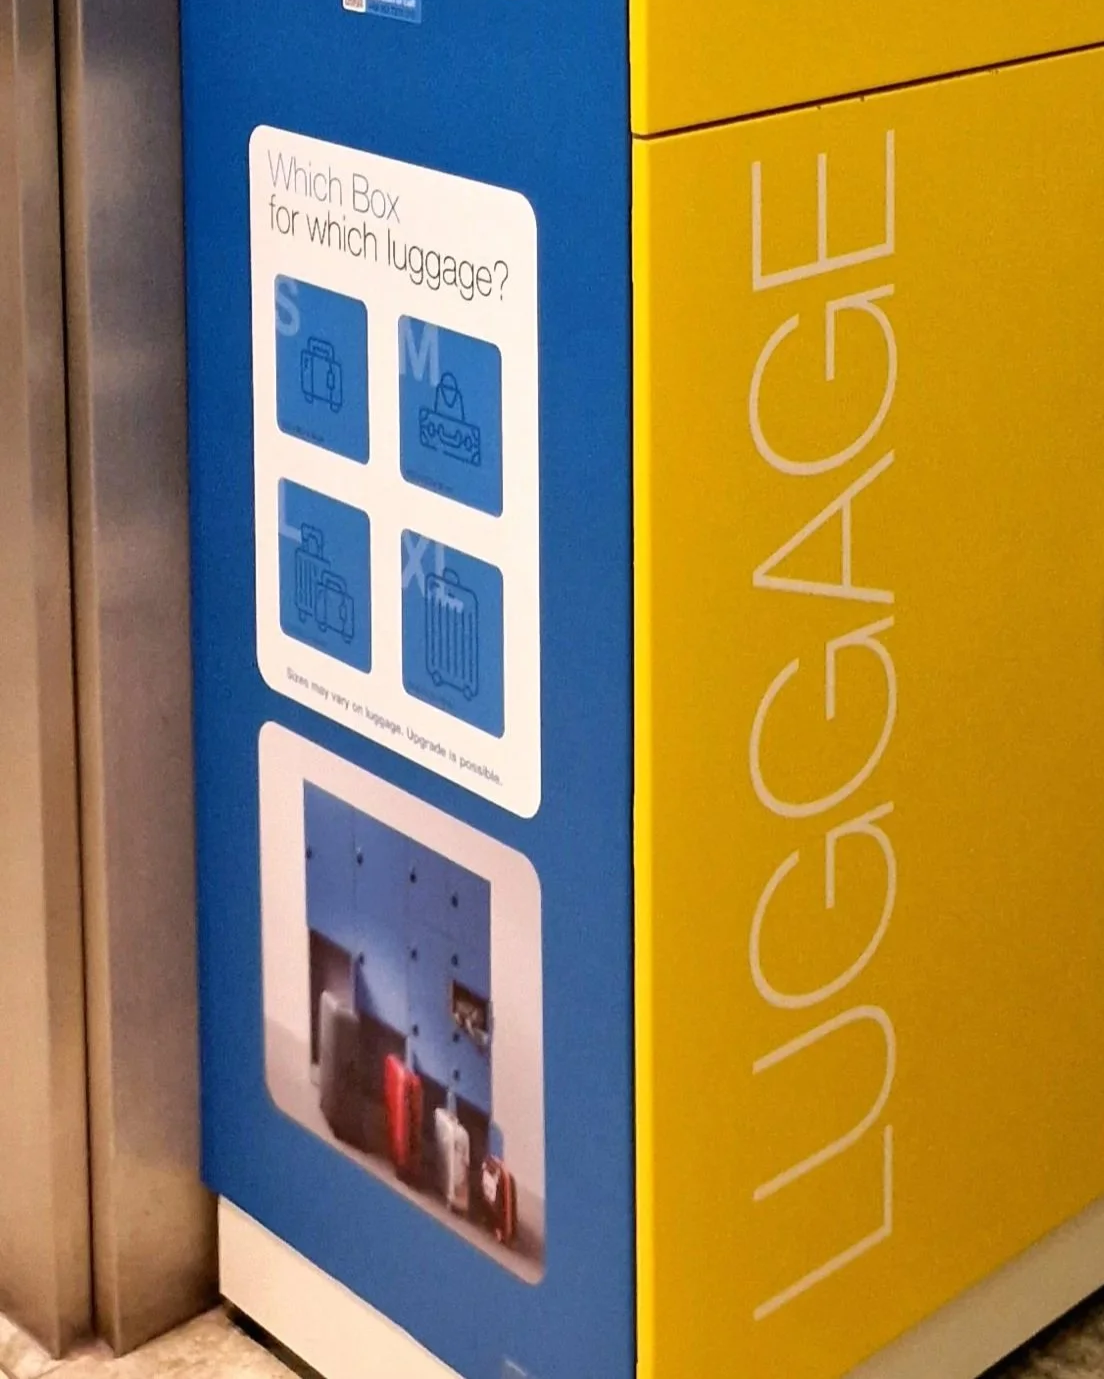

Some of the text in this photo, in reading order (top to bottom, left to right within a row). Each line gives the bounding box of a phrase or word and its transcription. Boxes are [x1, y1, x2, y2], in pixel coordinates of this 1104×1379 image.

[267, 149, 401, 224] Which Box
[268, 193, 509, 302] for which luggage?
[275, 279, 301, 337] S
[400, 315, 441, 388] M
[279, 478, 303, 543] L
[285, 666, 310, 688] Sizes
[310, 680, 330, 700] may
[331, 691, 351, 711] vary
[351, 703, 364, 718] on
[365, 707, 404, 737] luggage.
[406, 727, 447, 758] Upgrade
[459, 756, 503, 786] possible.
[748, 128, 898, 1320] LUGGAGE
